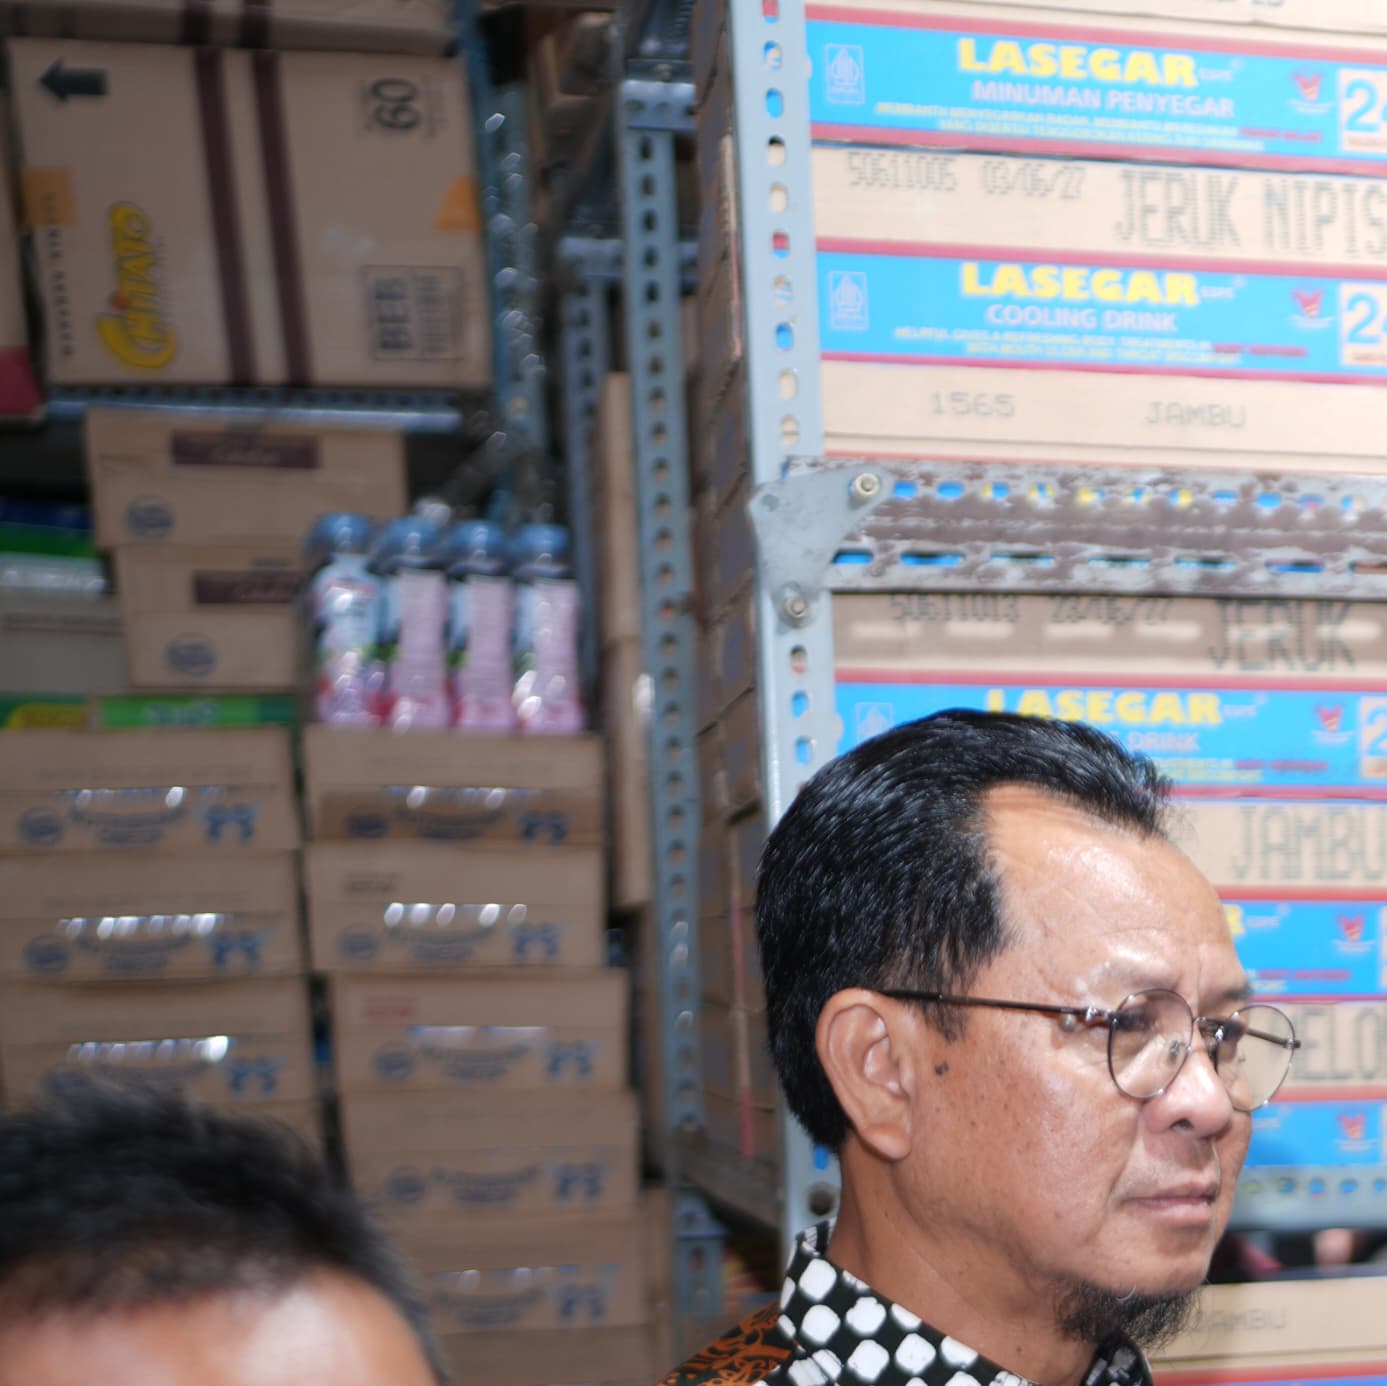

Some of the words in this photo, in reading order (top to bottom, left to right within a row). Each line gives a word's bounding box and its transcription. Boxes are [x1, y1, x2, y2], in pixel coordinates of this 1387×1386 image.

[957, 38, 1198, 87] LASEGAR
[972, 80, 1100, 112] MINUMAN
[1106, 88, 1236, 119] PENYEGAR
[1114, 166, 1240, 250] JERUK
[961, 263, 1199, 306] LASEGAR
[986, 303, 1097, 331] COOLING
[1102, 307, 1178, 334] DRINK
[1145, 401, 1248, 430] JAMBU
